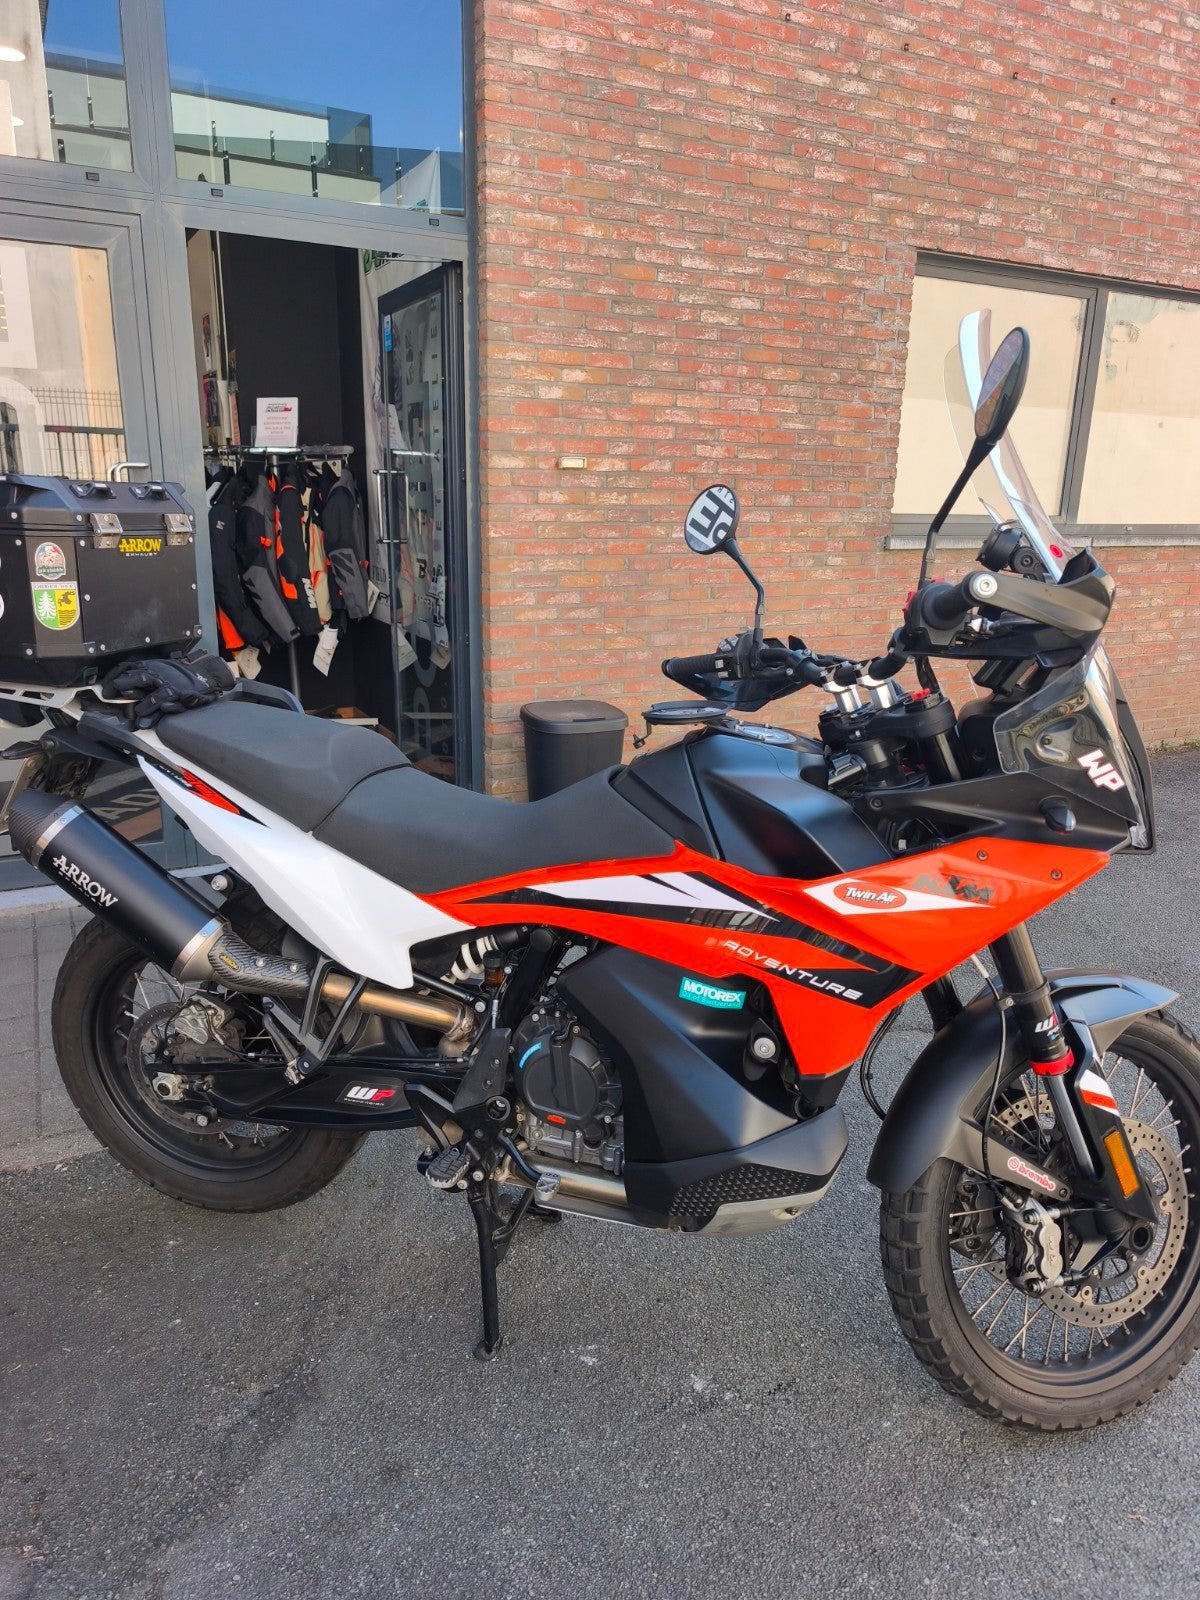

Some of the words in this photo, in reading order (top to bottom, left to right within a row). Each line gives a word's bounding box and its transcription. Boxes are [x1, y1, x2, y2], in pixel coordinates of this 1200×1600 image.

[119, 538, 162, 552] ARROW
[1077, 749, 1125, 791] WP
[52, 855, 118, 907] ARROW
[844, 886, 877, 901] Twin
[876, 891, 899, 903] Air
[722, 939, 864, 1001] ADVENTURE
[684, 980, 742, 1002] MOTOREX
[346, 1085, 397, 1102] WP
[1018, 1161, 1056, 1191] brembo
